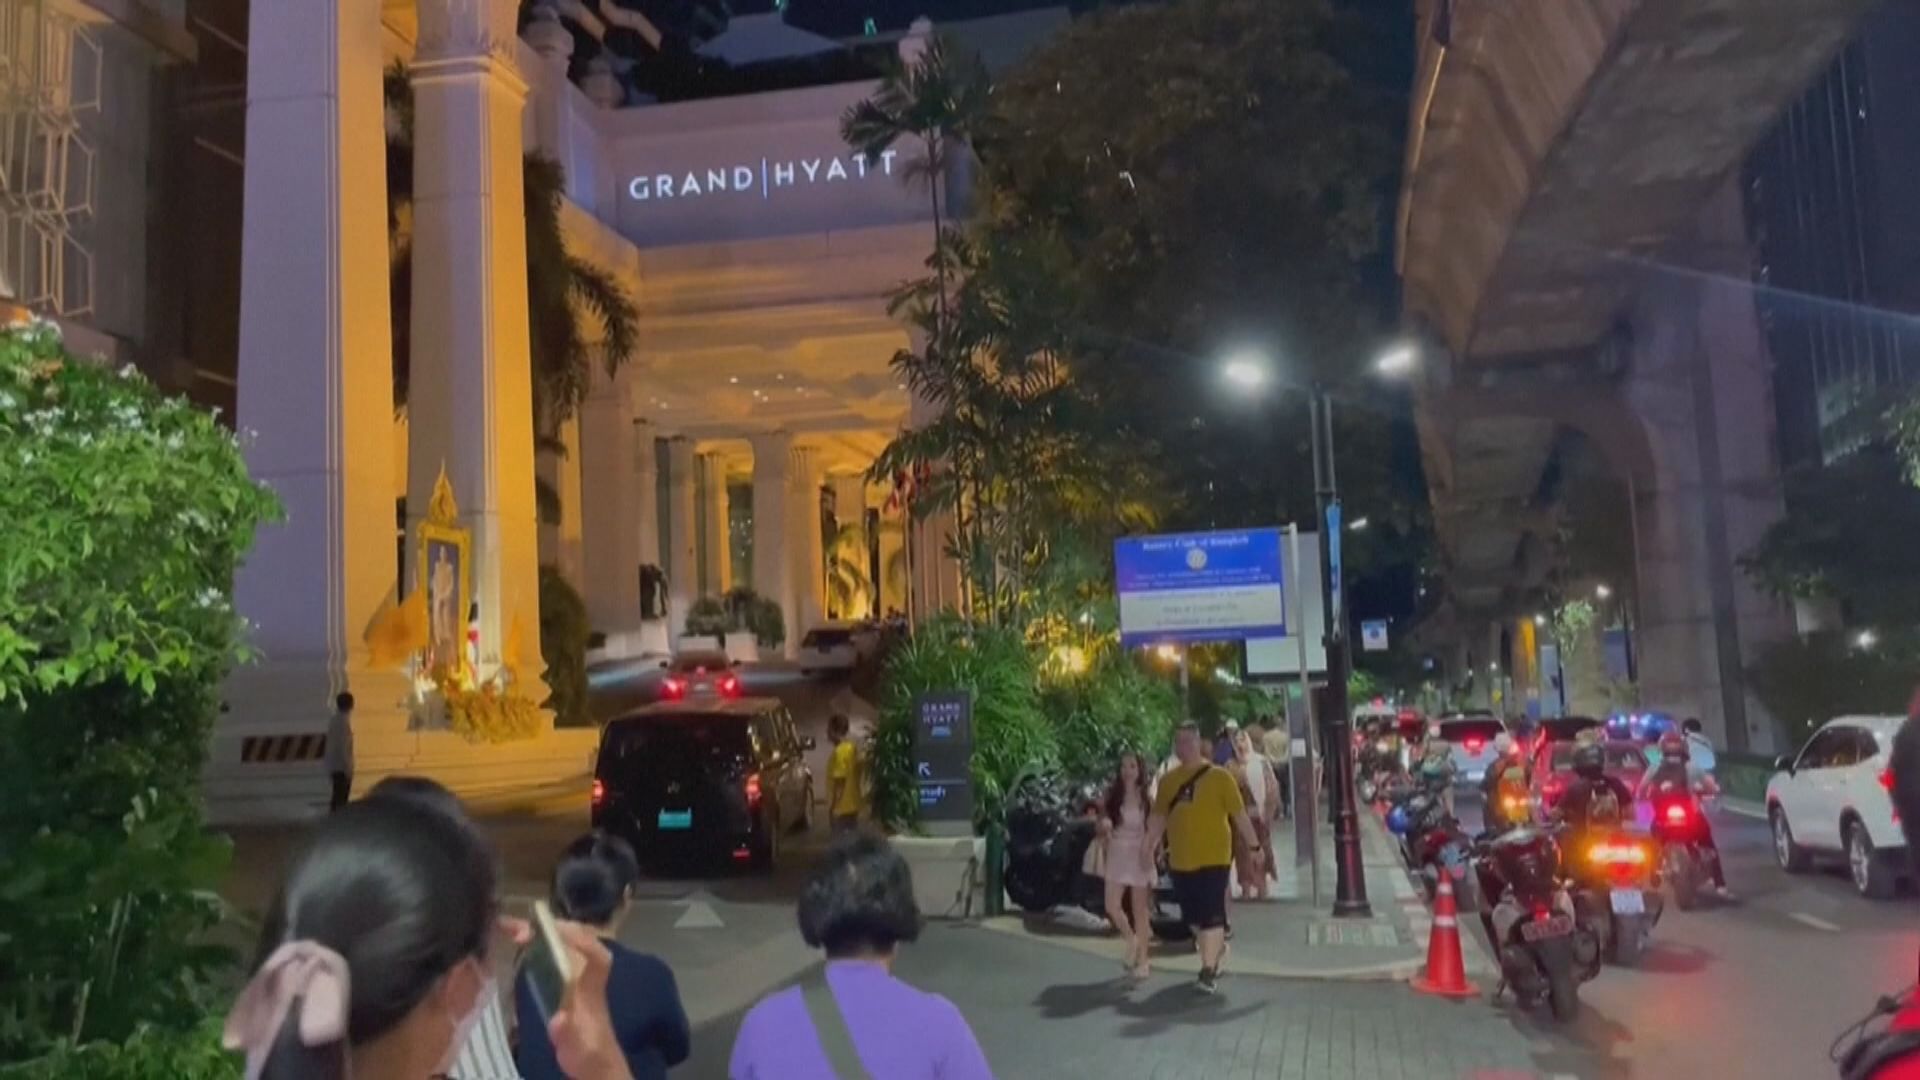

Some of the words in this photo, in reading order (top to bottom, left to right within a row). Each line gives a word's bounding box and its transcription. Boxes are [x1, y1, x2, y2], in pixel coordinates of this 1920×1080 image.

[629, 166, 754, 200] GRAND
[774, 150, 897, 186] HYATT
[922, 702, 960, 713] GRAND
[922, 714, 960, 724] HYATT
